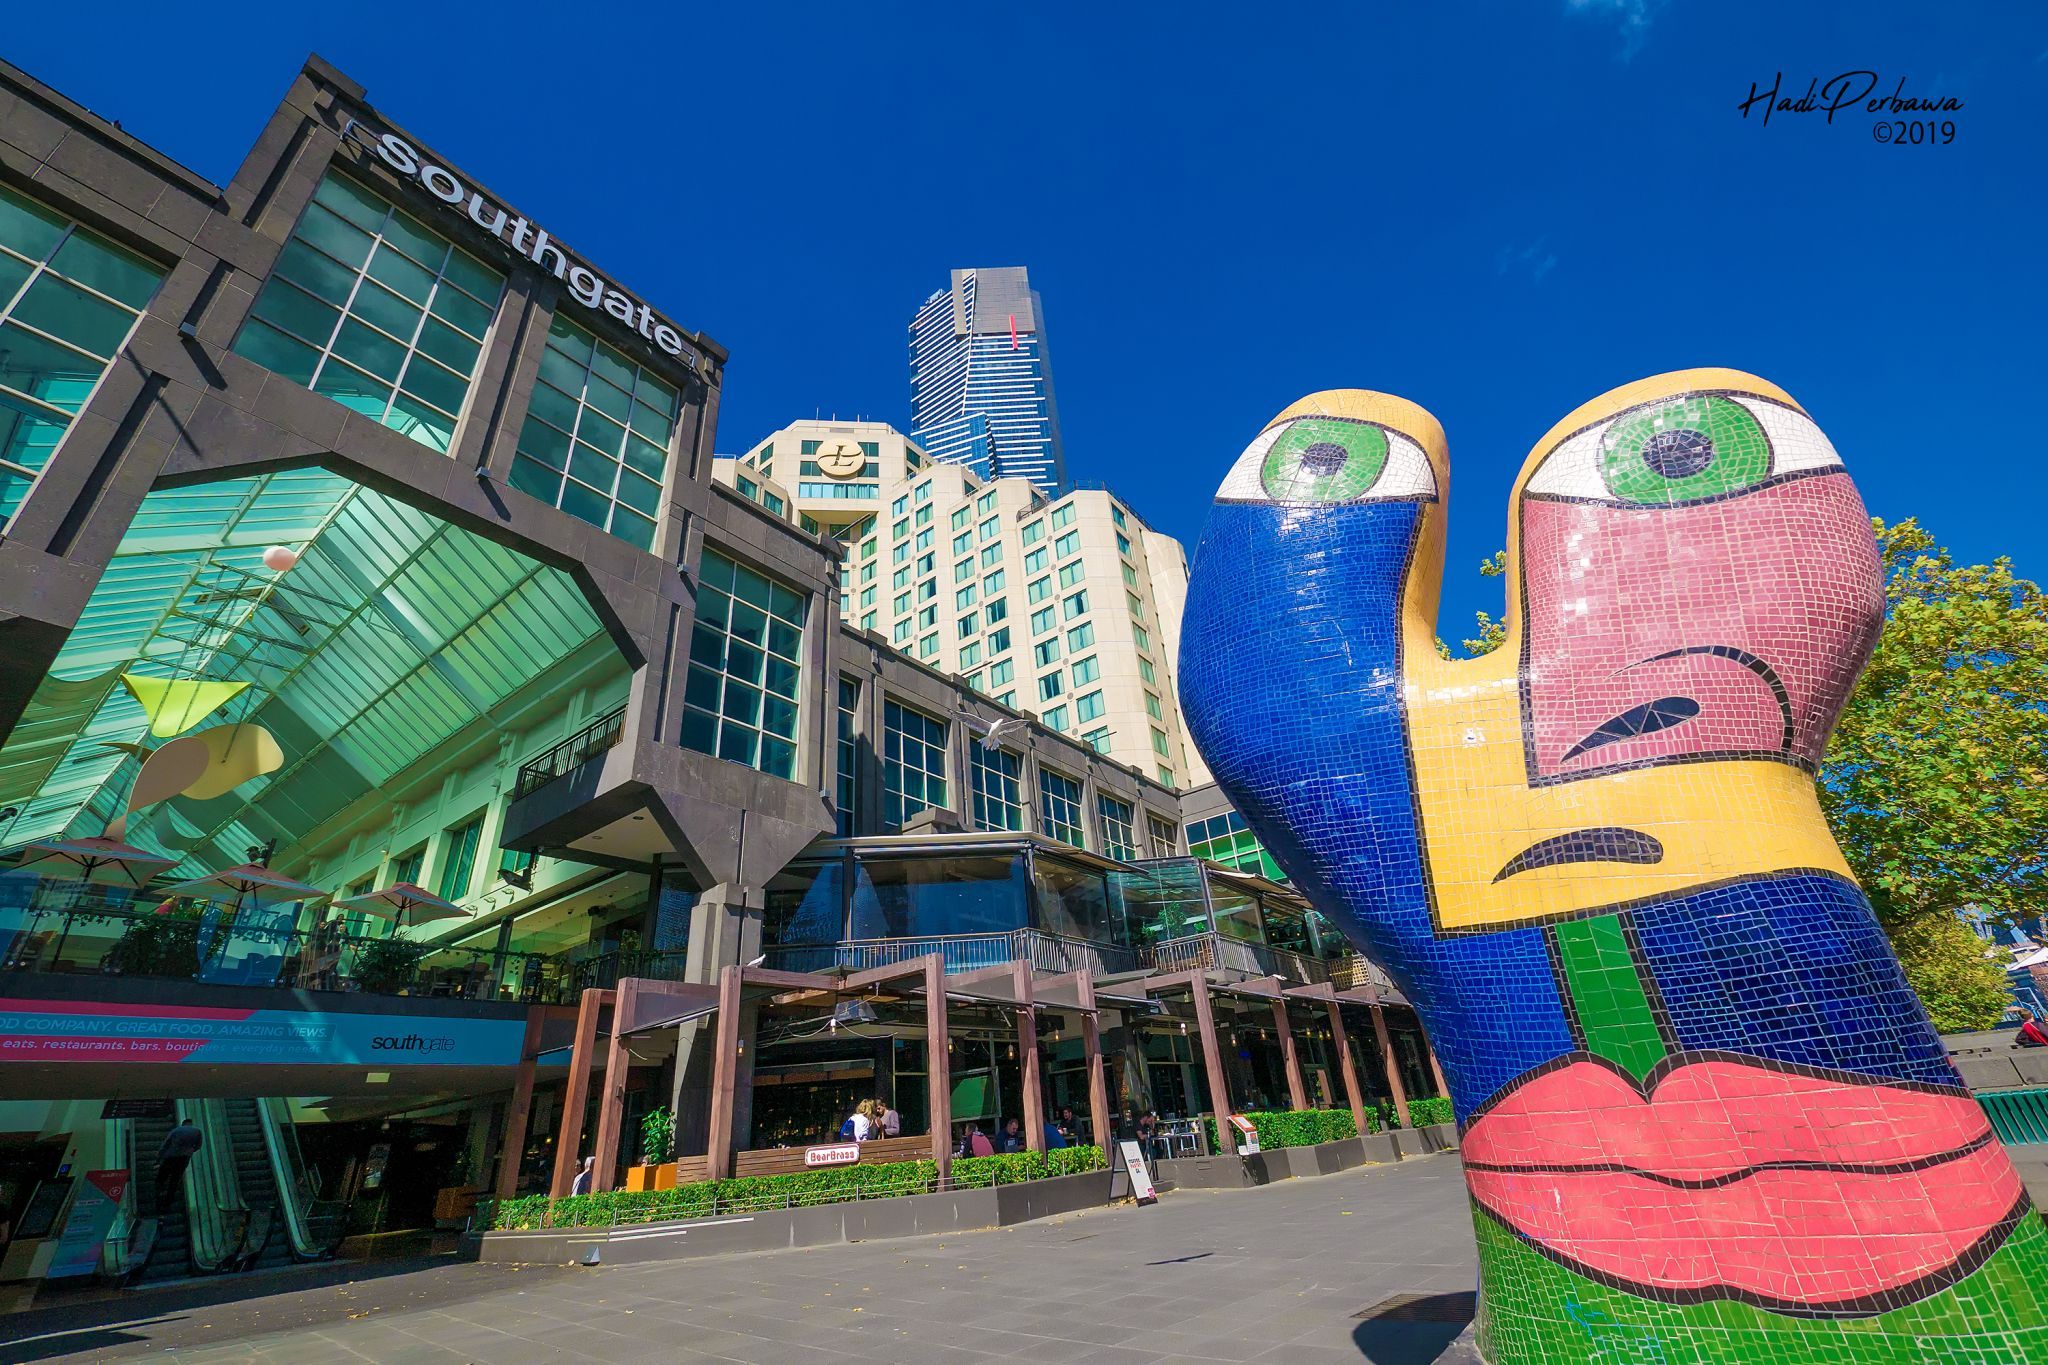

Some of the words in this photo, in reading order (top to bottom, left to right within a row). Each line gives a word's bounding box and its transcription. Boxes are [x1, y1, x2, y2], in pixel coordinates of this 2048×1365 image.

[376, 132, 683, 356] southgate
[24, 1018, 111, 1032] COMPANY.
[116, 1022, 167, 1034] GREAT
[168, 1023, 214, 1035] FOOD.
[218, 1025, 285, 1037] AMAZING
[286, 1026, 328, 1038] VIEWS.
[3, 1039, 38, 1049] eats.
[42, 1040, 126, 1051] restaurants.
[130, 1040, 162, 1051] bars.
[371, 1034, 456, 1055] southgate
[810, 1150, 856, 1162] BearBrass
